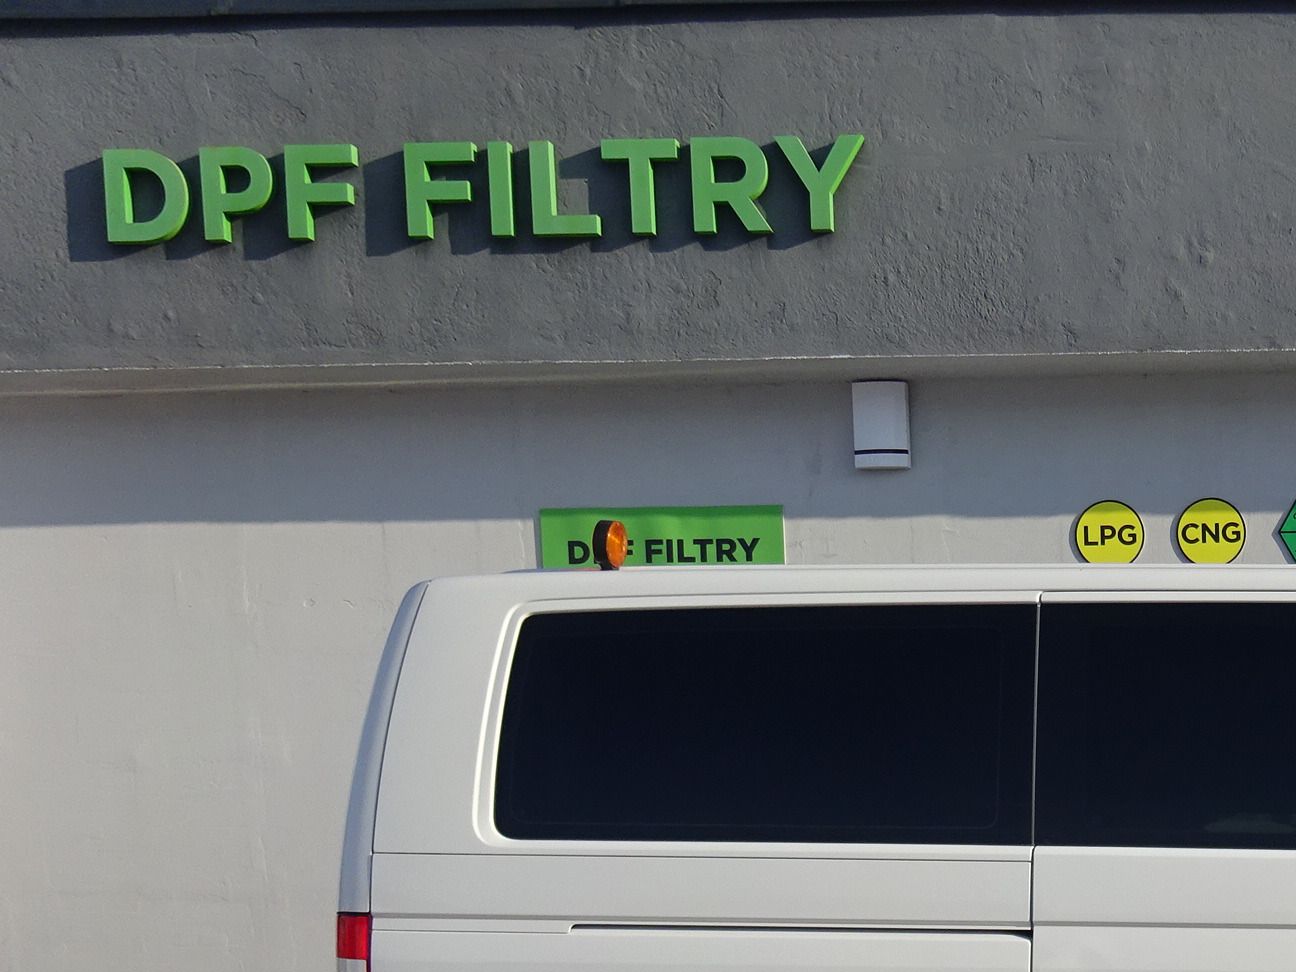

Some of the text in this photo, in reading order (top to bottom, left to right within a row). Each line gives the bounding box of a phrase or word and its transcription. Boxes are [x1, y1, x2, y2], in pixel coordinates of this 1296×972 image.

[102, 134, 864, 245] DPF FILTRY
[1083, 524, 1137, 546] LPG
[1181, 521, 1241, 545] CNG
[645, 537, 760, 563] FILTRY
